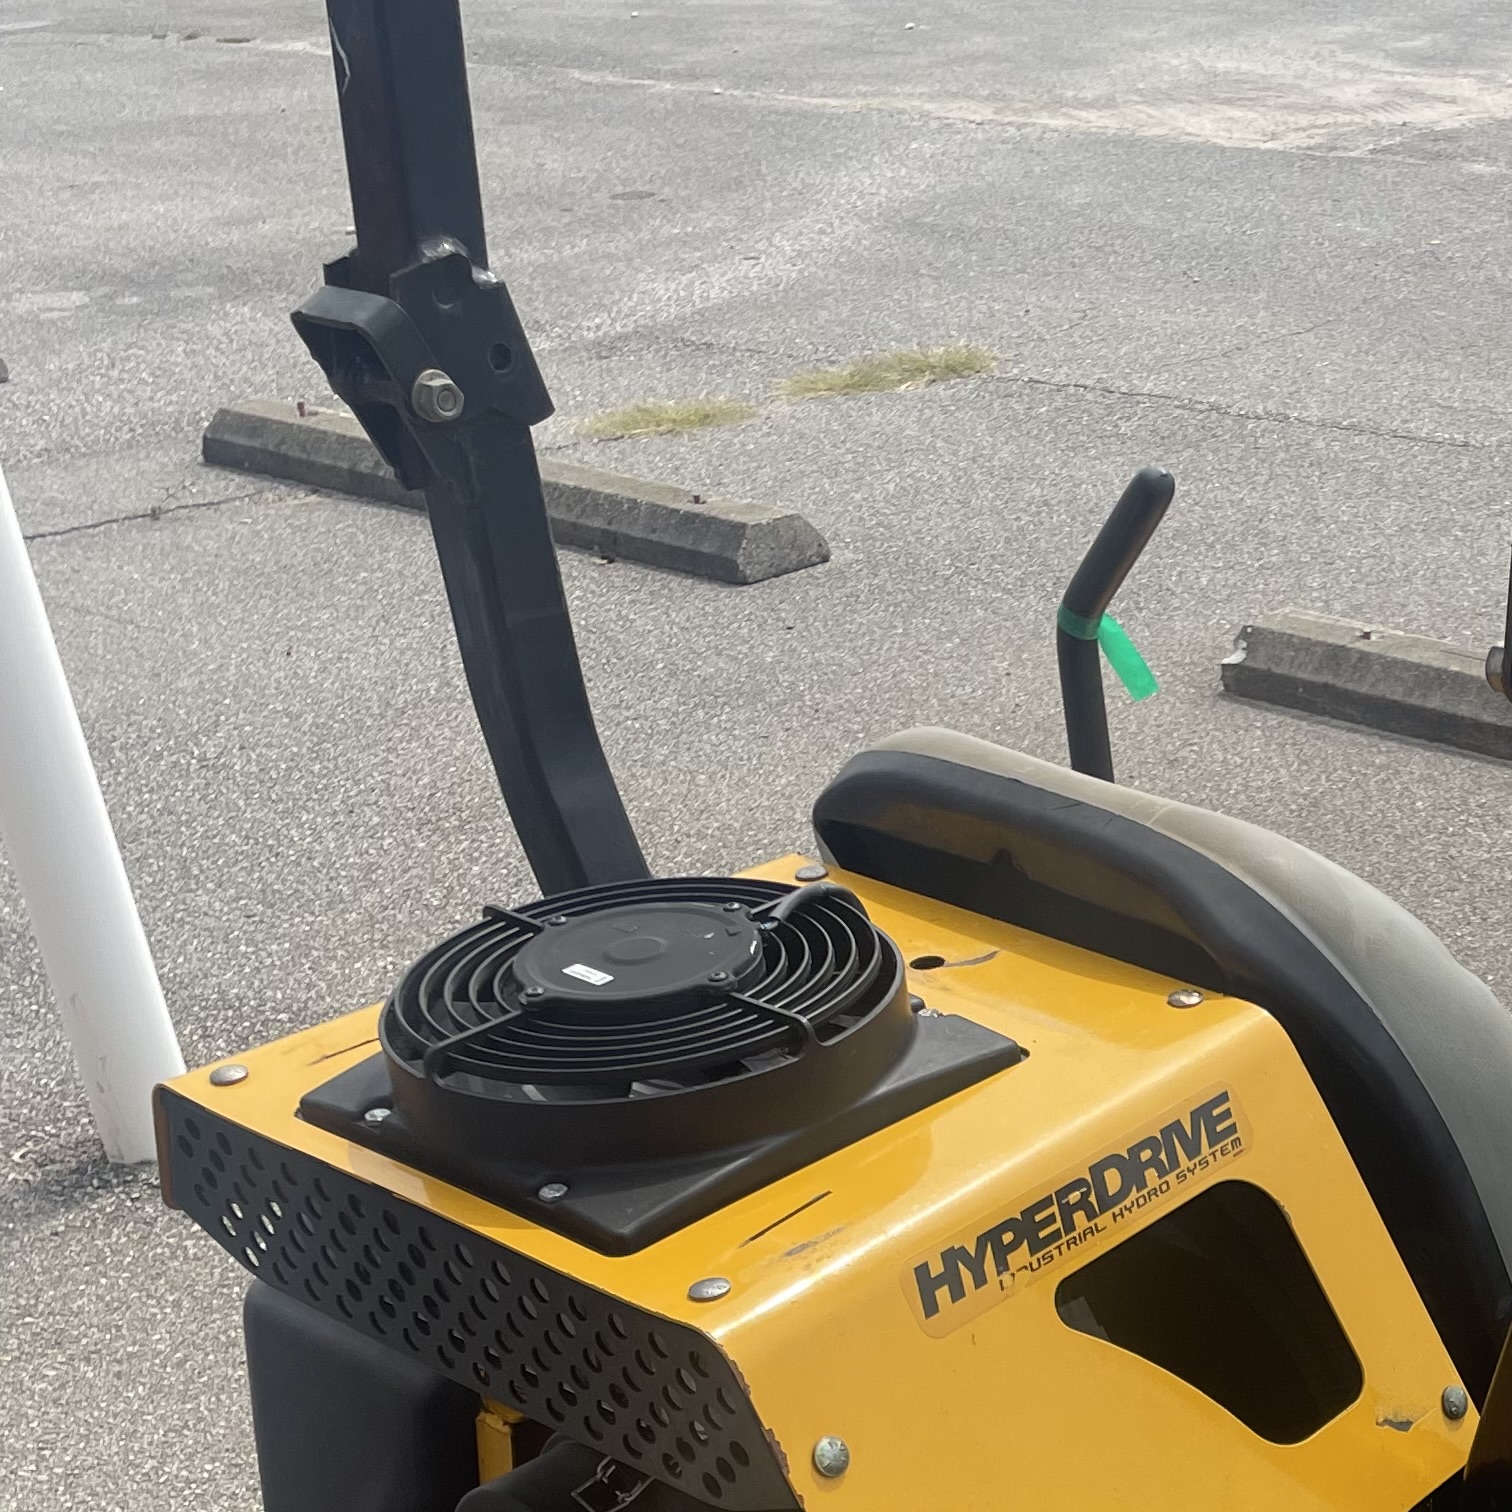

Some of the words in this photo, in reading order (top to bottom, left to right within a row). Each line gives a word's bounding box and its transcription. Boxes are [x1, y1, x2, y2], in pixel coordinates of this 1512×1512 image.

[913, 1089, 1238, 1320] HYPERDRIVE
[998, 1222, 1107, 1292] IUSTRIAL
[1112, 1179, 1171, 1224] HYDRO
[1176, 1136, 1243, 1185] SYSTEM
